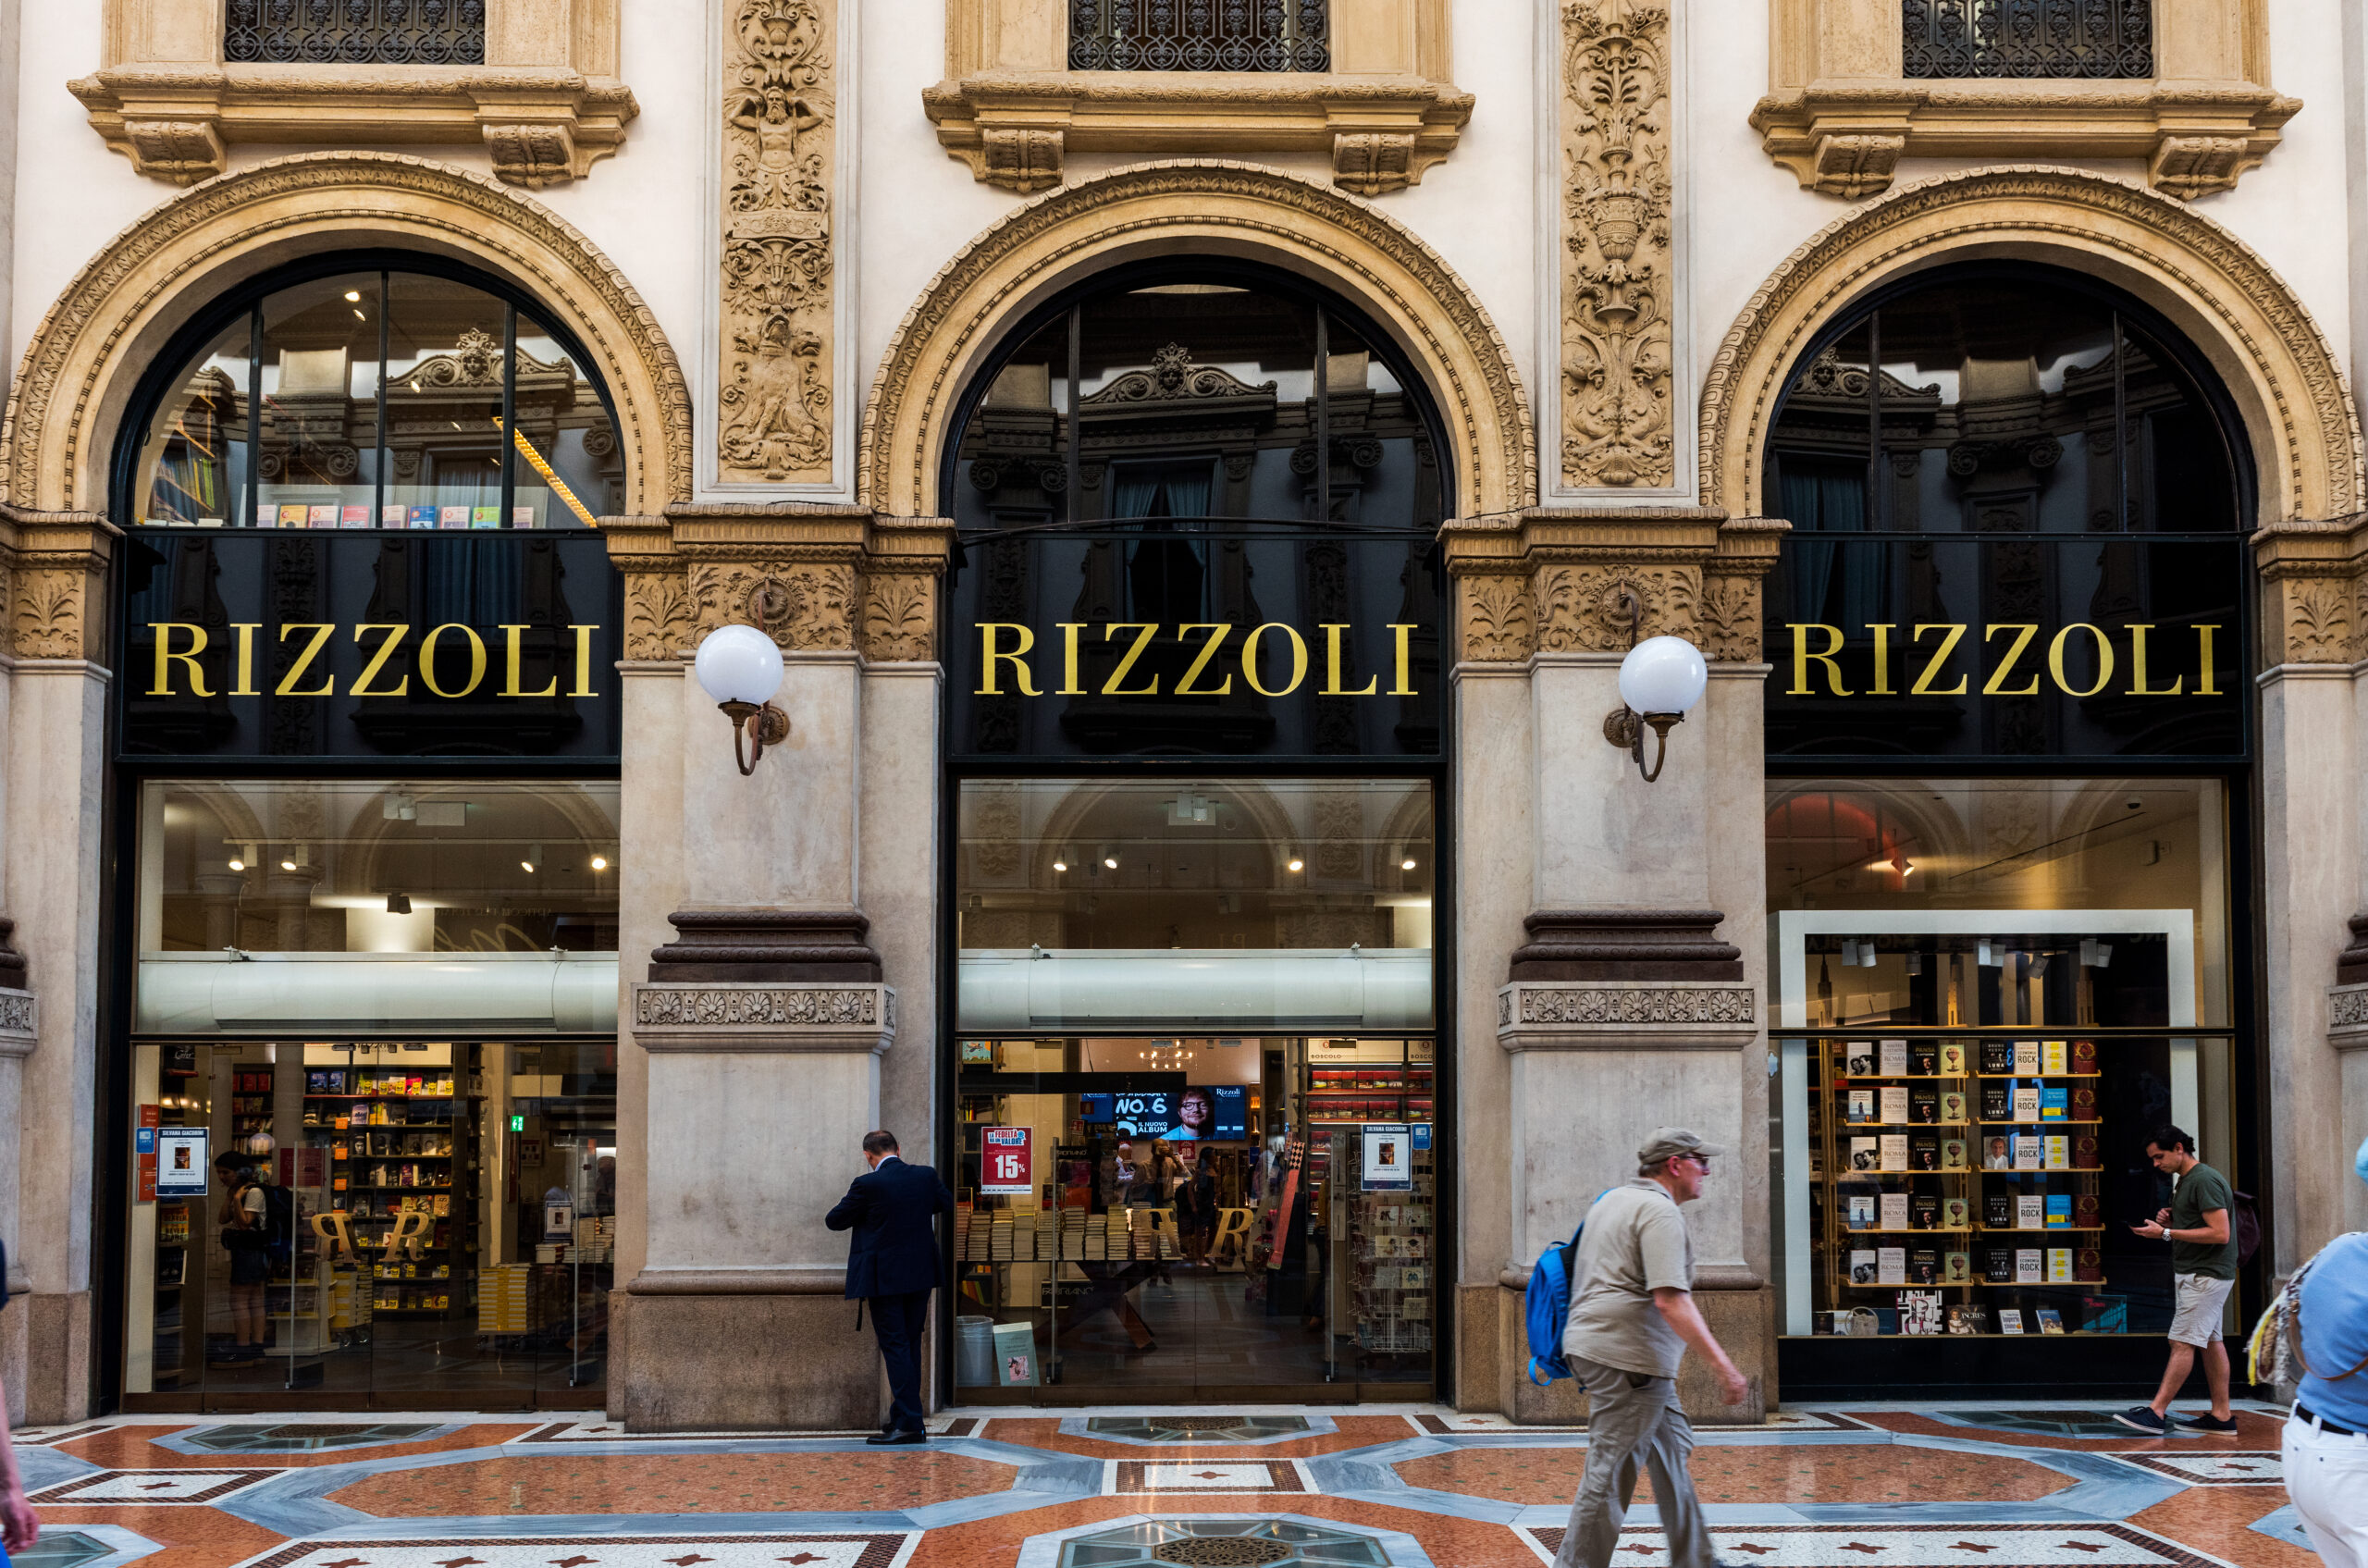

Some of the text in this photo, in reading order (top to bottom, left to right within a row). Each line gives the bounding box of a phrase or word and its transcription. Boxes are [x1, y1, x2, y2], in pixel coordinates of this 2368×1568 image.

[145, 623, 600, 698] RIZZOLI
[973, 622, 1419, 698] RIZZOLI
[1784, 623, 2224, 697] RIZZOLI
[2017, 1056, 2037, 1064] ROCK
[1216, 1088, 1240, 1097] Rizzoli
[2017, 1102, 2037, 1110] ROCK
[995, 1129, 1018, 1138] FEDELTÀ
[1001, 1137, 1022, 1145] VALORE
[2018, 1150, 2038, 1158] ROCK
[2020, 1209, 2041, 1217] ROCK
[2019, 1263, 2040, 1271] ROCK
